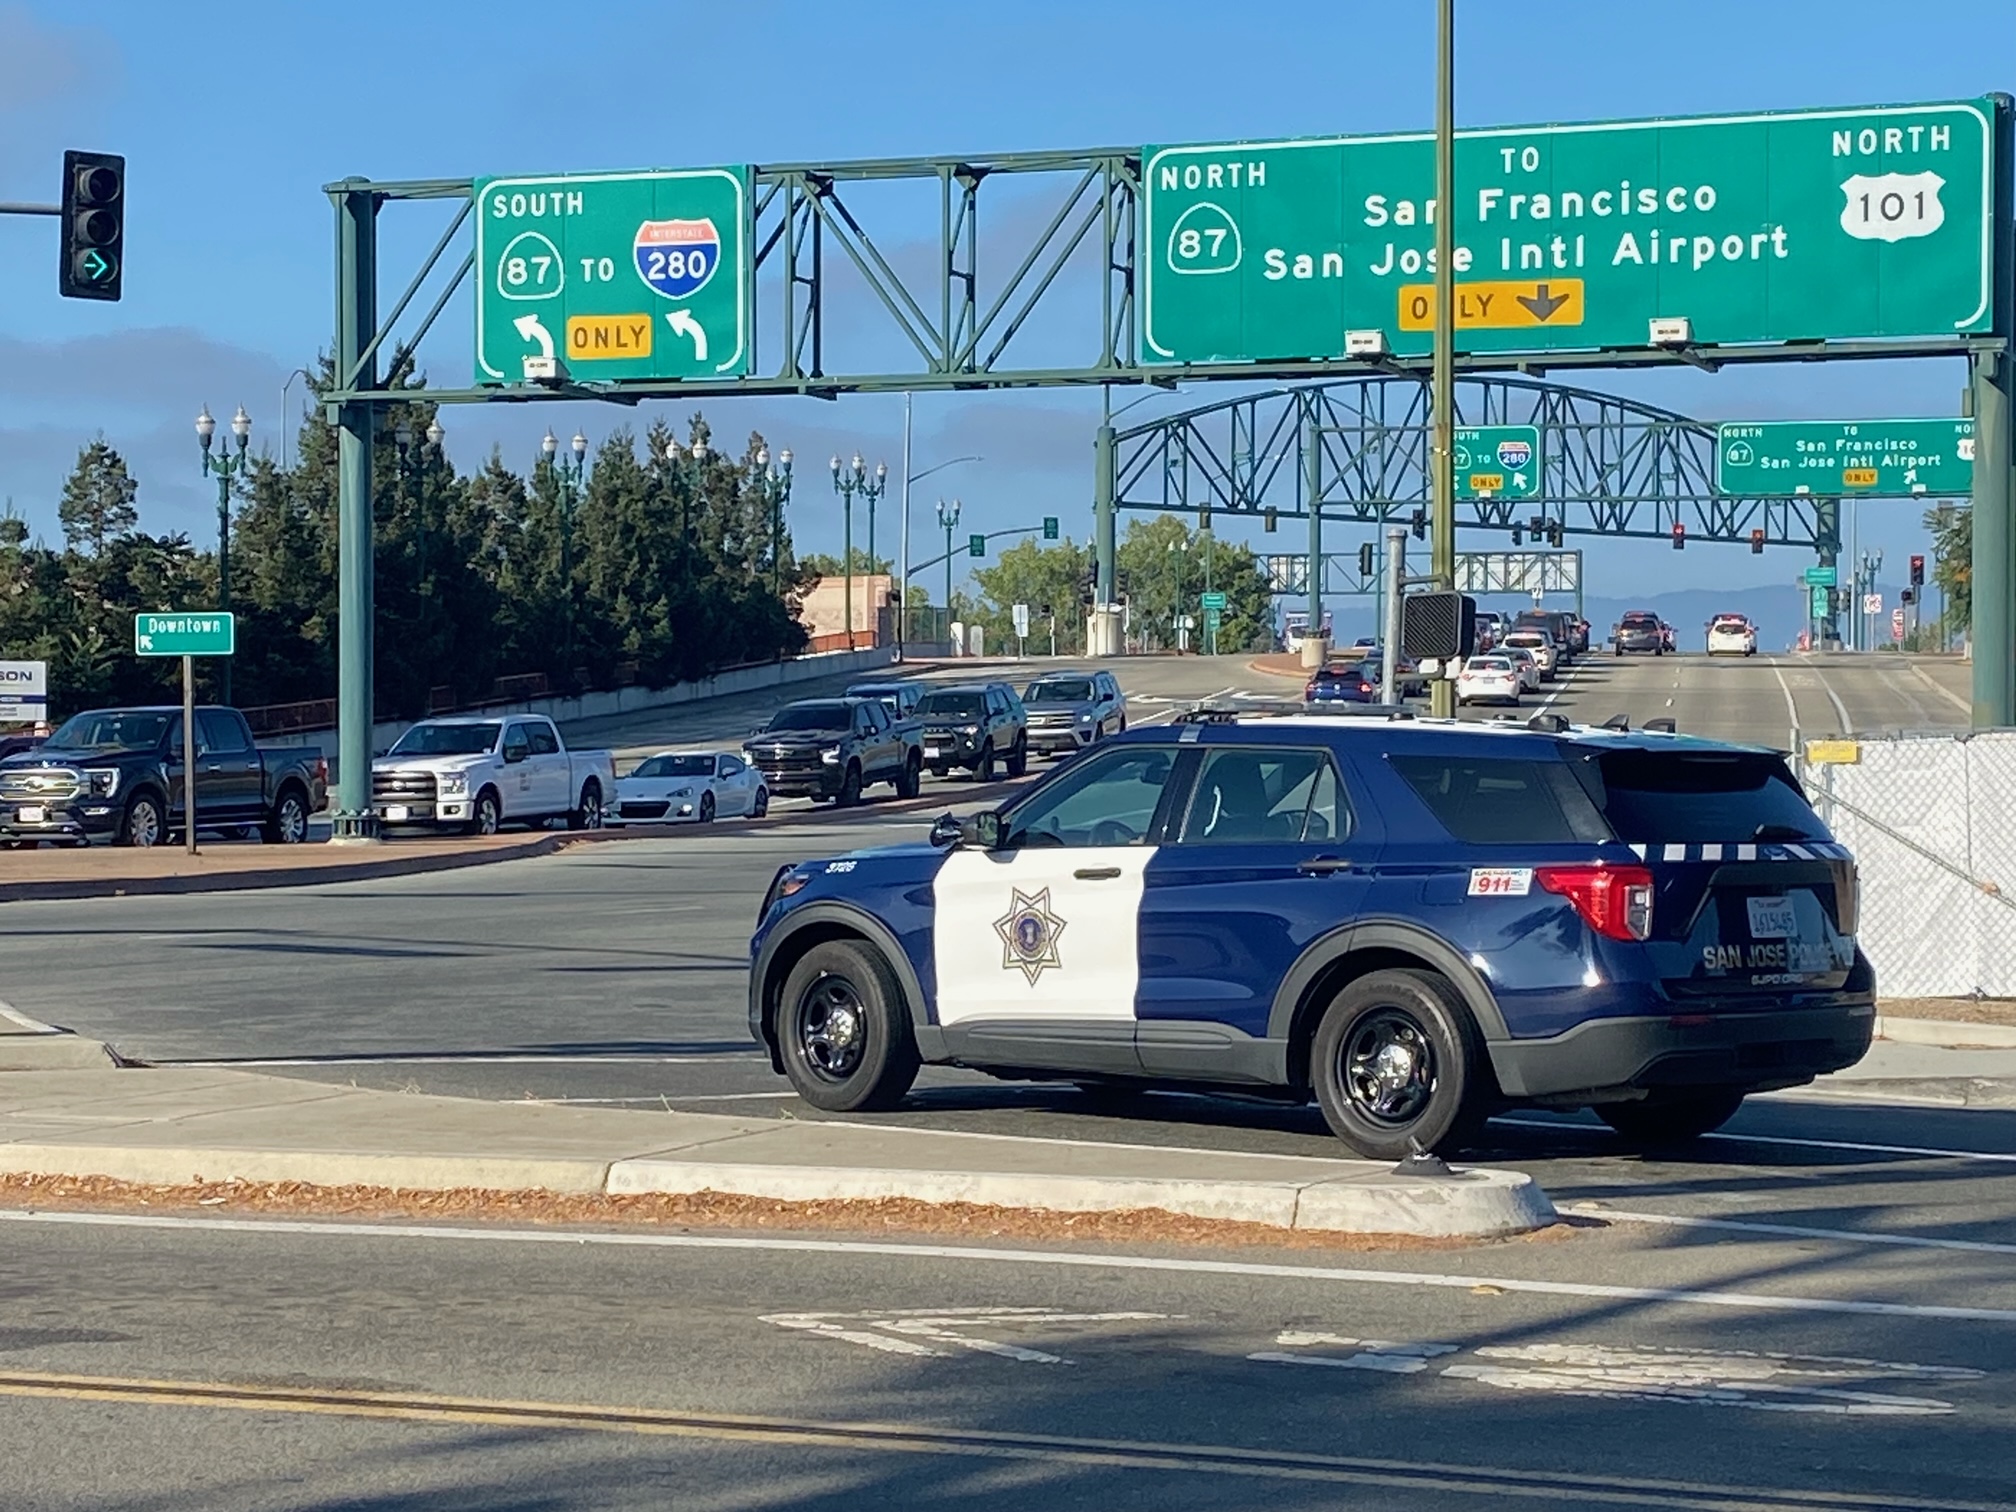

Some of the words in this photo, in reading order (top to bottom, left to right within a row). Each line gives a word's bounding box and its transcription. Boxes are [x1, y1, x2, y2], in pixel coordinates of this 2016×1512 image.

[1832, 125, 1950, 157] NORTH
[1500, 146, 1539, 173] TO
[1161, 161, 1266, 191] NORTH
[492, 191, 583, 218] SOUTH
[1478, 180, 1718, 222] Francisco
[1859, 191, 1925, 222] 101
[1178, 229, 1227, 259] 87
[1263, 249, 1343, 281] San
[1501, 234, 1585, 270] Intl
[1612, 225, 1789, 271] Airport
[506, 256, 551, 285] 87
[581, 258, 614, 282] TO
[648, 250, 707, 280] 280
[1412, 293, 1494, 320] OLY
[574, 325, 646, 349] ONLY
[1723, 427, 1763, 438] NORTH
[1843, 426, 1858, 436] TO
[1730, 449, 1748, 461] 87
[1796, 440, 1826, 452] San
[1836, 438, 1917, 451] Francisco
[1477, 454, 1491, 464] TO
[1502, 453, 1526, 464] 280
[1760, 456, 1791, 469] San
[1798, 456, 1835, 468] Jose
[1843, 455, 1873, 467] Intl
[1881, 453, 1941, 469] Airport
[1472, 476, 1502, 487] ONLY
[1845, 473, 1875, 482] ONLY
[149, 618, 221, 634] Downtown
[1478, 876, 1512, 893] 911
[1703, 944, 1742, 969] SAN
[1746, 943, 1786, 967] JOSE
